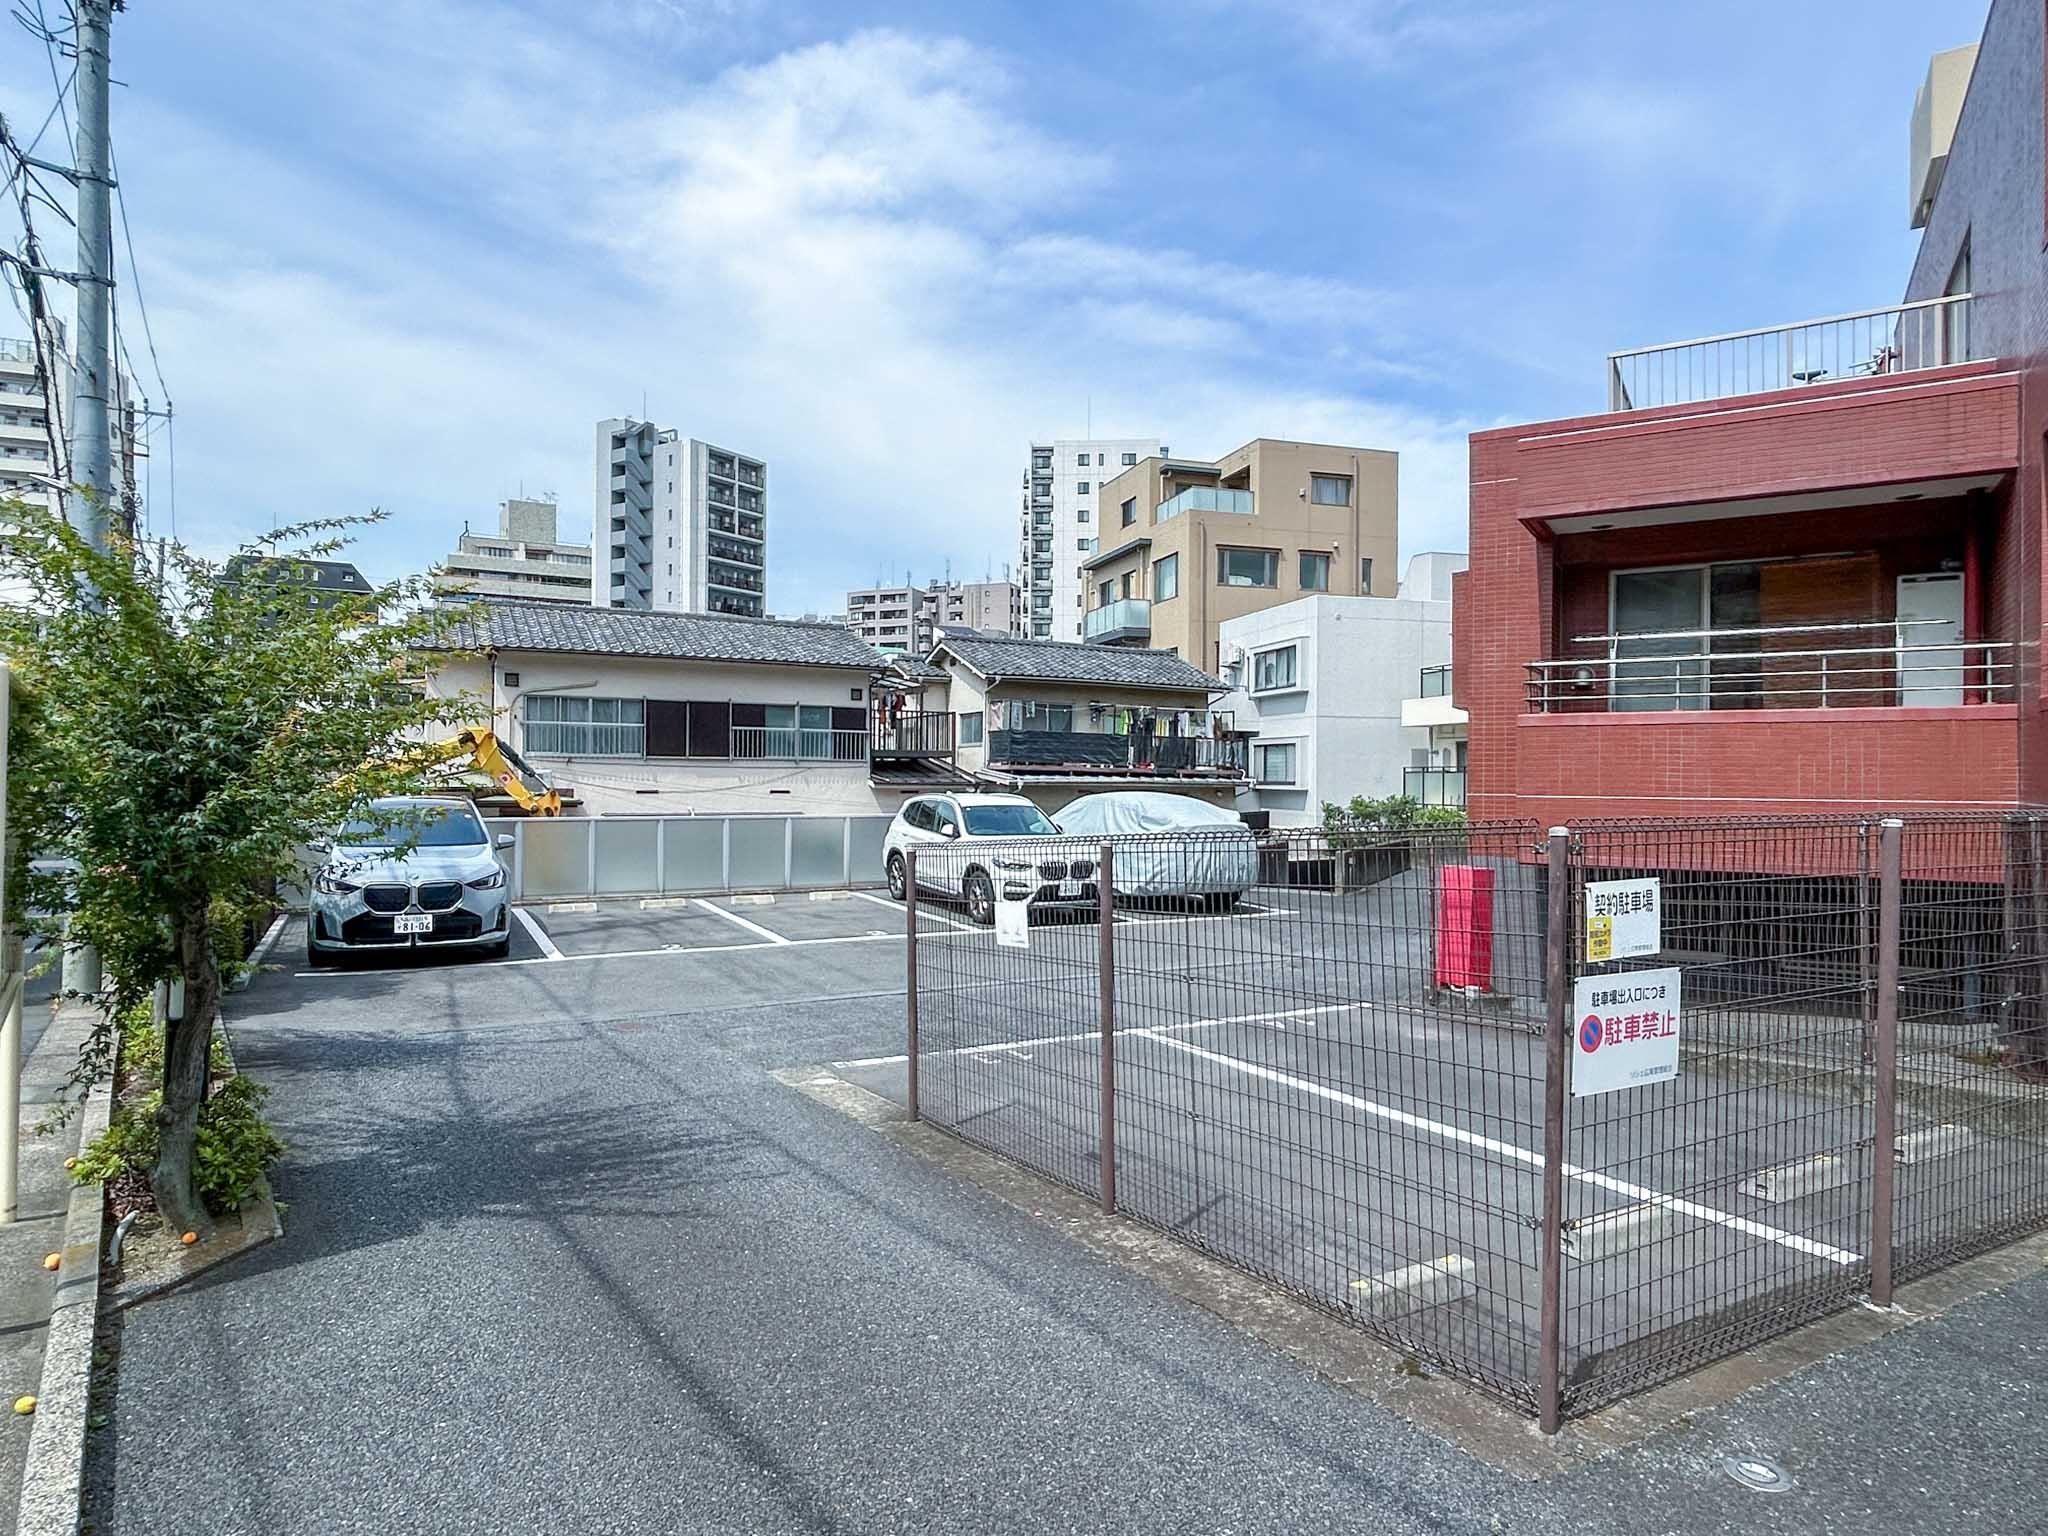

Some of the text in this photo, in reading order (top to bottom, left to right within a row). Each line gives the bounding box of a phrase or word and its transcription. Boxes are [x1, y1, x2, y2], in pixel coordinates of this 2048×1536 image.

[1594, 889, 1654, 917] 契約駐車場
[1591, 985, 1666, 1008] 駐車場出入口につき
[1604, 1009, 1676, 1047] 駐車禁止
